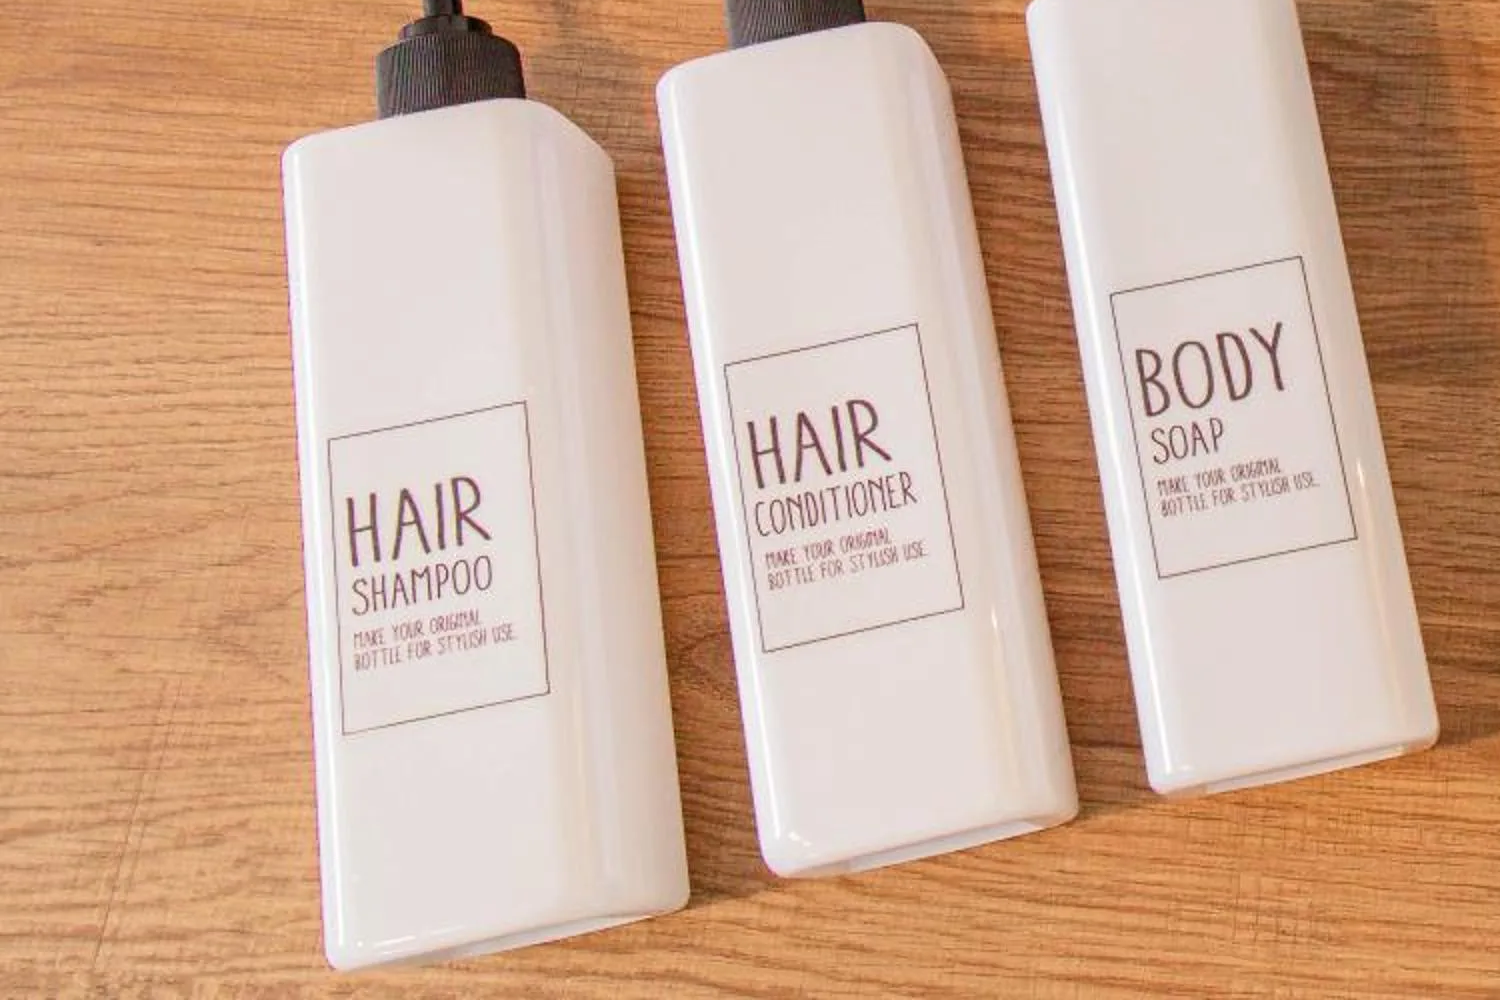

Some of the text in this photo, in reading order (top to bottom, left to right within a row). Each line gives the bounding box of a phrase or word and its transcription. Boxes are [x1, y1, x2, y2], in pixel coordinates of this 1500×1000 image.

[1135, 321, 1285, 417] BODY
[747, 400, 893, 489] HAIR
[1151, 417, 1224, 465] SOAP
[755, 471, 918, 537] CONDITIONER
[1157, 476, 1190, 496] MAKE
[1160, 495, 1208, 518] BOTTLE
[1211, 487, 1236, 507] FOR
[346, 477, 493, 567] HAIR
[765, 548, 798, 570] MAKE
[767, 565, 815, 591] BOTTLE
[820, 558, 844, 579] FOR
[352, 555, 493, 616] SHAMPOO
[353, 627, 386, 649] MAKE
[391, 619, 423, 641] YOUR
[354, 648, 402, 672] BOTTLE
[407, 639, 433, 660] FOR
